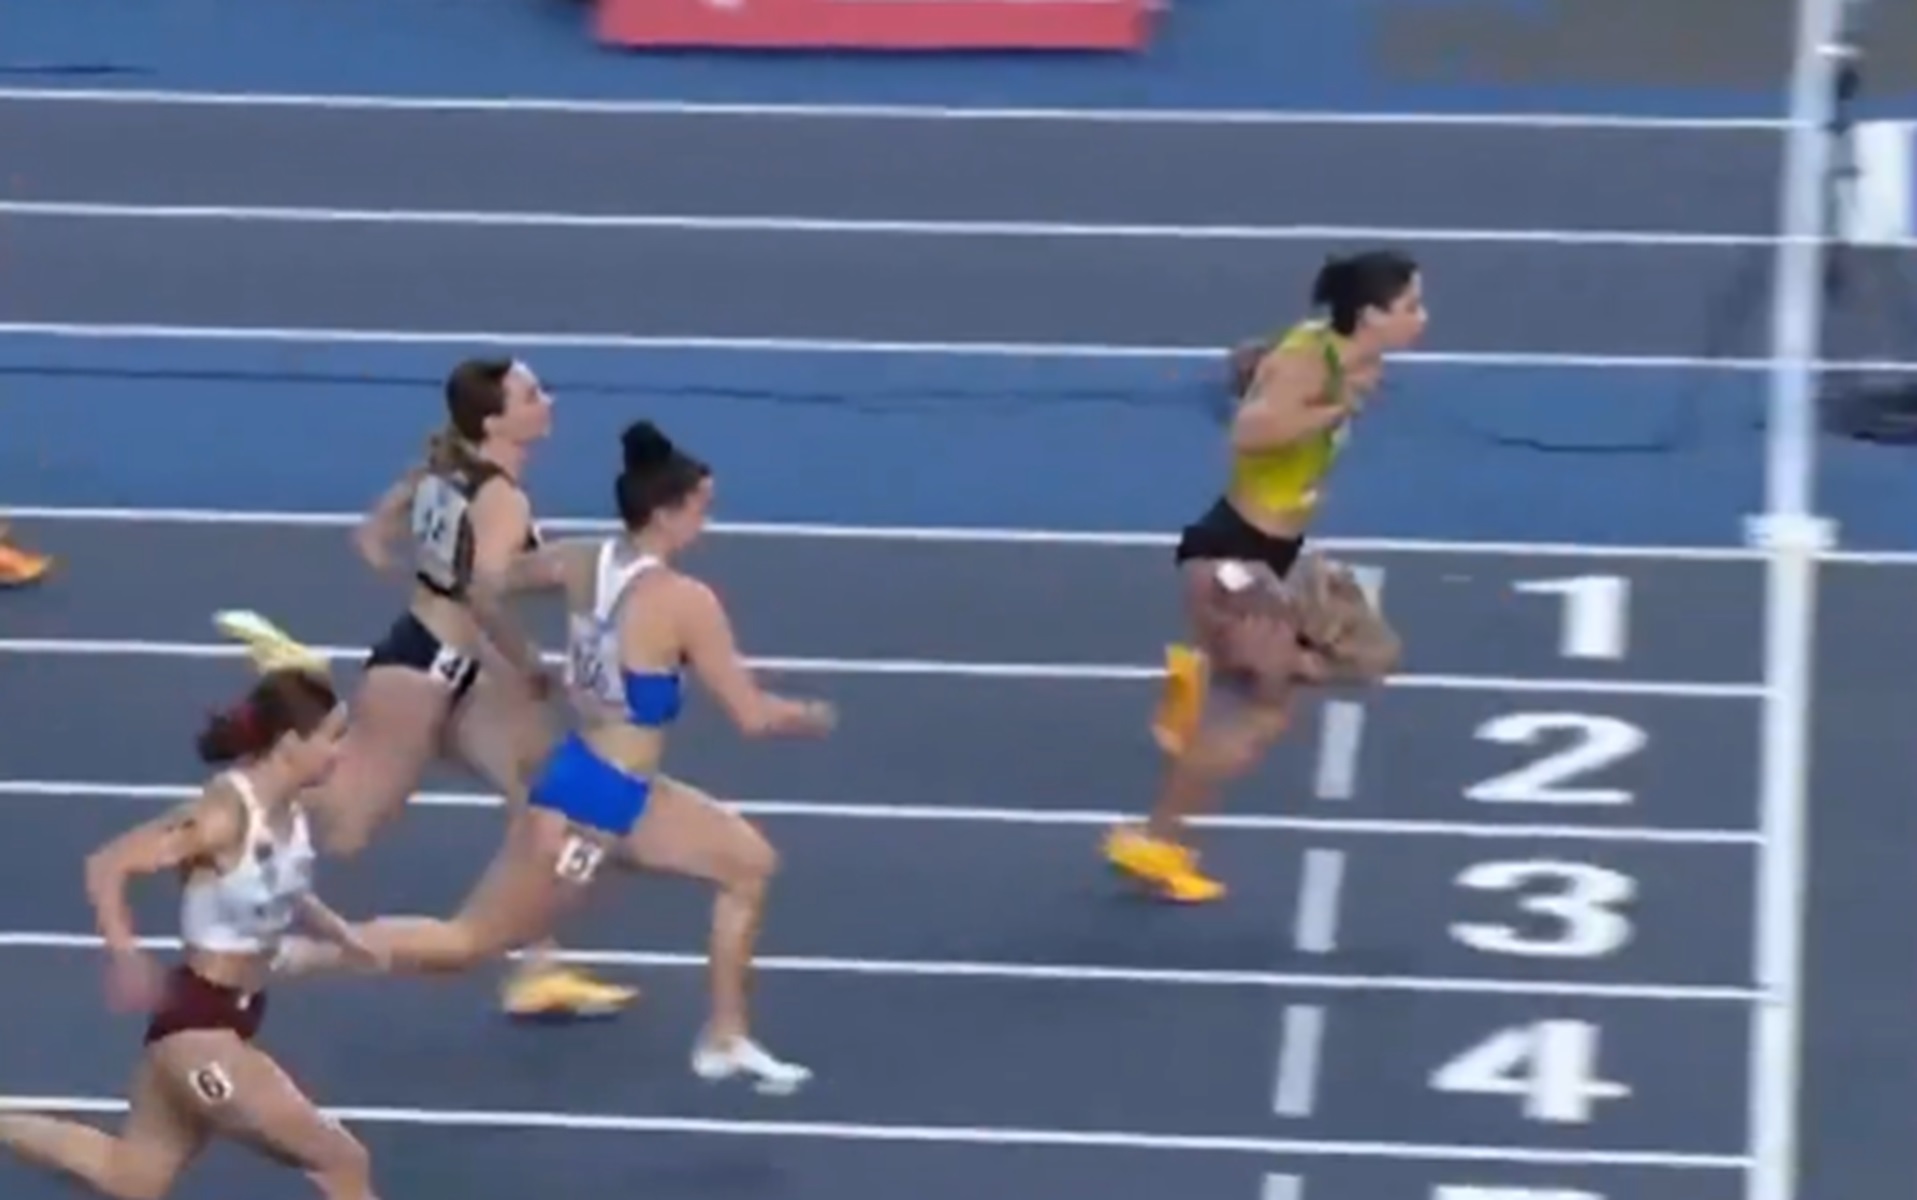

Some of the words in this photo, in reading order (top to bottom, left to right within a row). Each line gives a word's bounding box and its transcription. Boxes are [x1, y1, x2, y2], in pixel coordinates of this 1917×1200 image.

[1512, 575, 1630, 660] 1
[1463, 712, 1648, 805] 2
[1448, 860, 1637, 958] 3
[1428, 1018, 1632, 1123] 4
